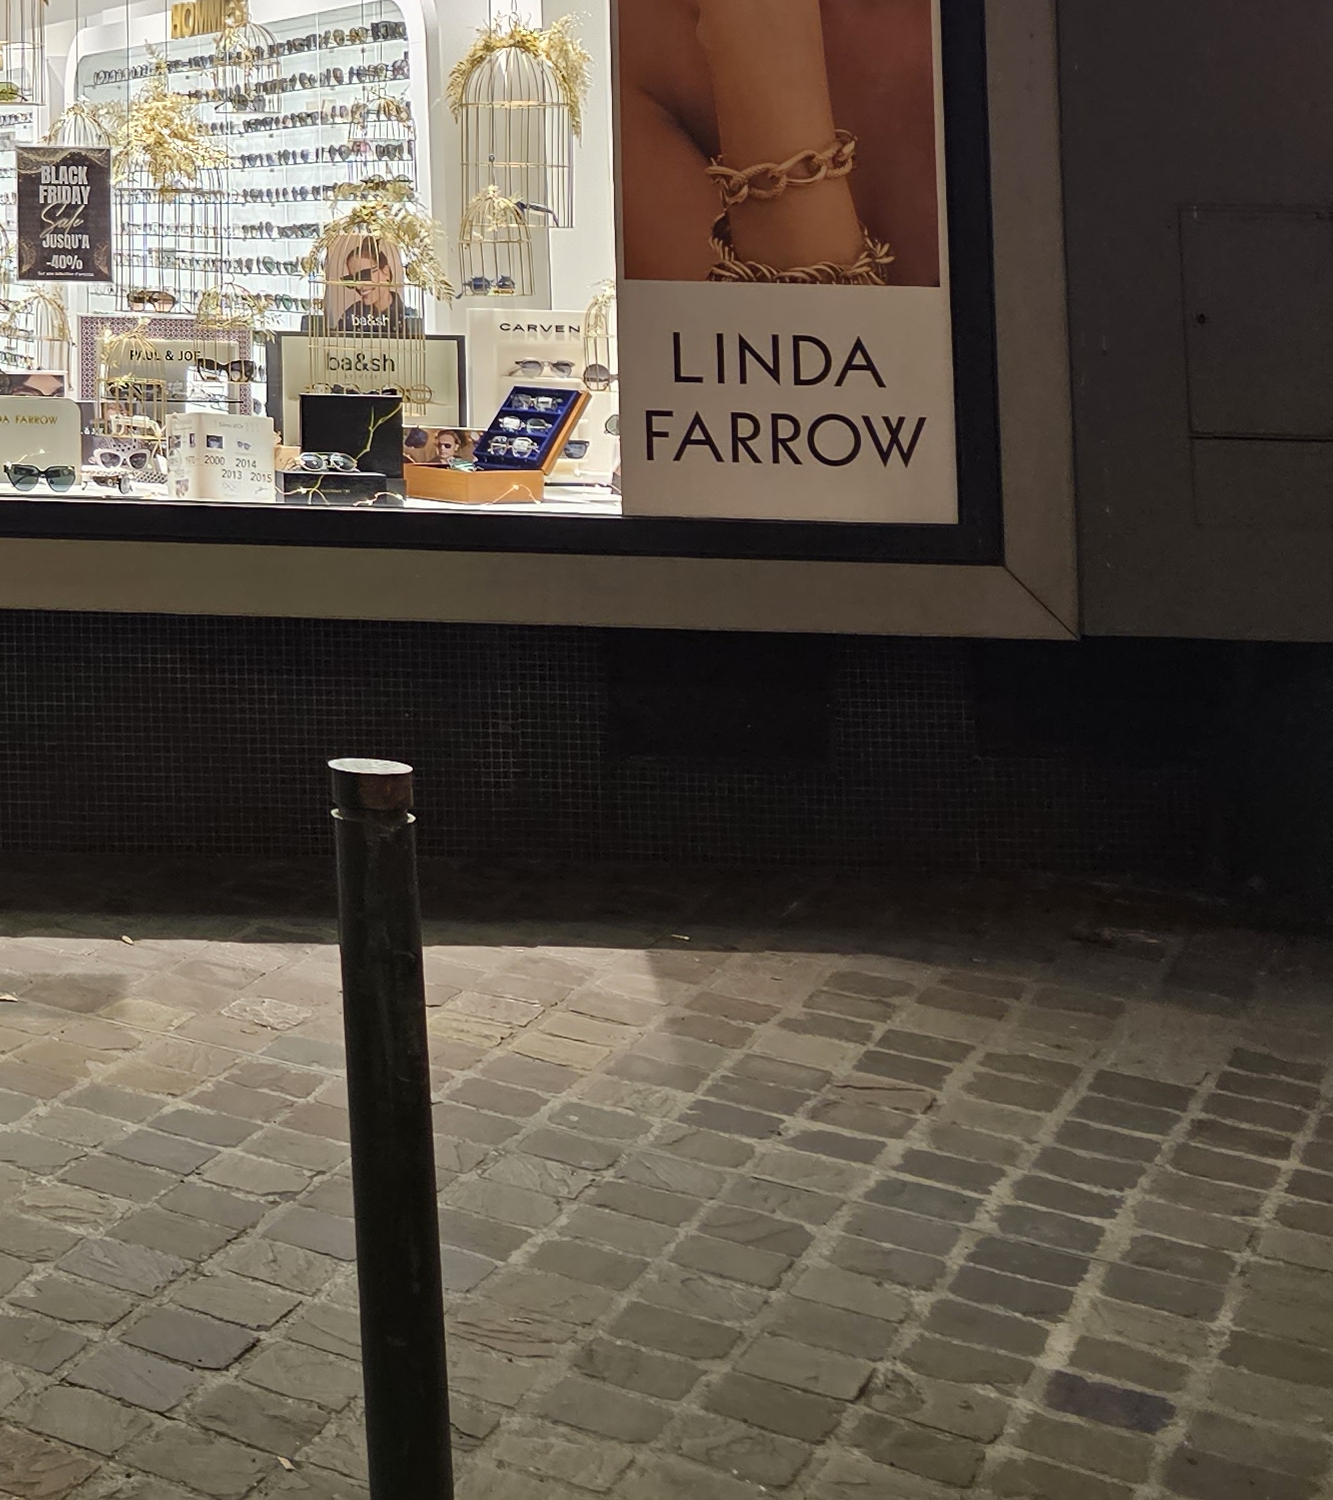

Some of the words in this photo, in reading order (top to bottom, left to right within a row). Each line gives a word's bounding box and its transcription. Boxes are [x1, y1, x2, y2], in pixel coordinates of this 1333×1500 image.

[41, 165, 88, 185] BLACK
[39, 185, 91, 205] FRIDAY
[39, 202, 85, 238] Sale
[42, 233, 90, 249] JUSQU'A
[46, 255, 84, 270] -40%
[351, 314, 390, 327] ba&sh
[499, 323, 581, 333] CARVEN
[130, 350, 160, 361] PAUL
[165, 351, 174, 361] &
[327, 353, 395, 372] ba&sh
[672, 332, 887, 388] LINDA
[15, 415, 58, 425] FARROW
[645, 410, 927, 468] FARROW
[204, 455, 225, 466] 2000
[235, 458, 257, 468] 2014
[222, 469, 243, 480] 2013
[250, 472, 273, 483] 2015
